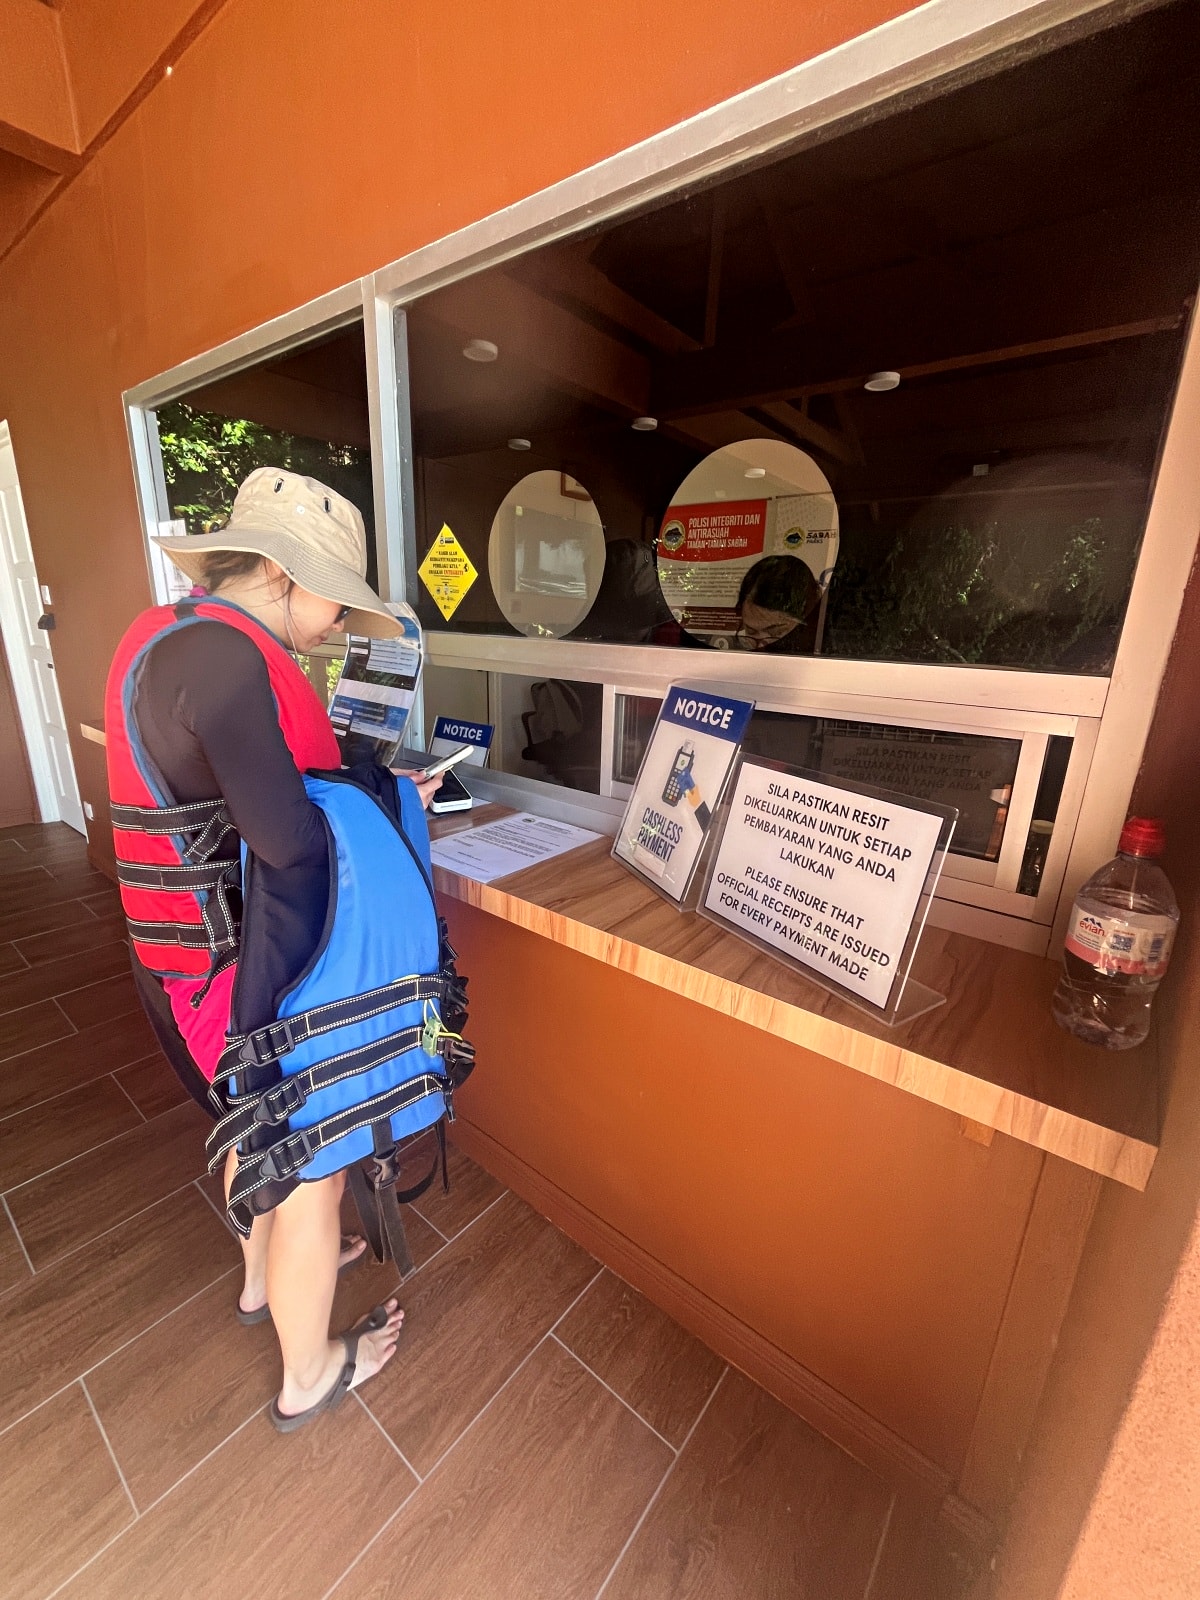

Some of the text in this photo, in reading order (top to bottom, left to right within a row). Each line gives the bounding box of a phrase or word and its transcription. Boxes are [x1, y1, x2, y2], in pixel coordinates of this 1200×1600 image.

[688, 513, 760, 528] POLISI INTEGRITI DAN
[688, 528, 730, 539] ANTIRASUAH
[806, 531, 837, 539] SABAH
[686, 538, 748, 549] TAMAN-TAMAN SABAH
[674, 697, 734, 730] NOTICE
[442, 723, 483, 741] NOTICE
[767, 783, 890, 831] SILA PASTIKAN RESIT
[642, 807, 684, 845] CASHLESS
[744, 795, 912, 861] DIKELUARKAN UNTUK SETIAP
[637, 826, 676, 863] PAYMENT
[744, 814, 895, 882] PEMBAYARAN YANG ANDA
[780, 848, 835, 880] LAKUKAN
[744, 866, 864, 930] PLEASE ENSURE THAT
[718, 872, 890, 967] OFFICIAL RECEIPTS ARE ISSUED
[720, 892, 869, 981] FOR EVERY PAYMENT MADE
[1079, 920, 1105, 937] evian
